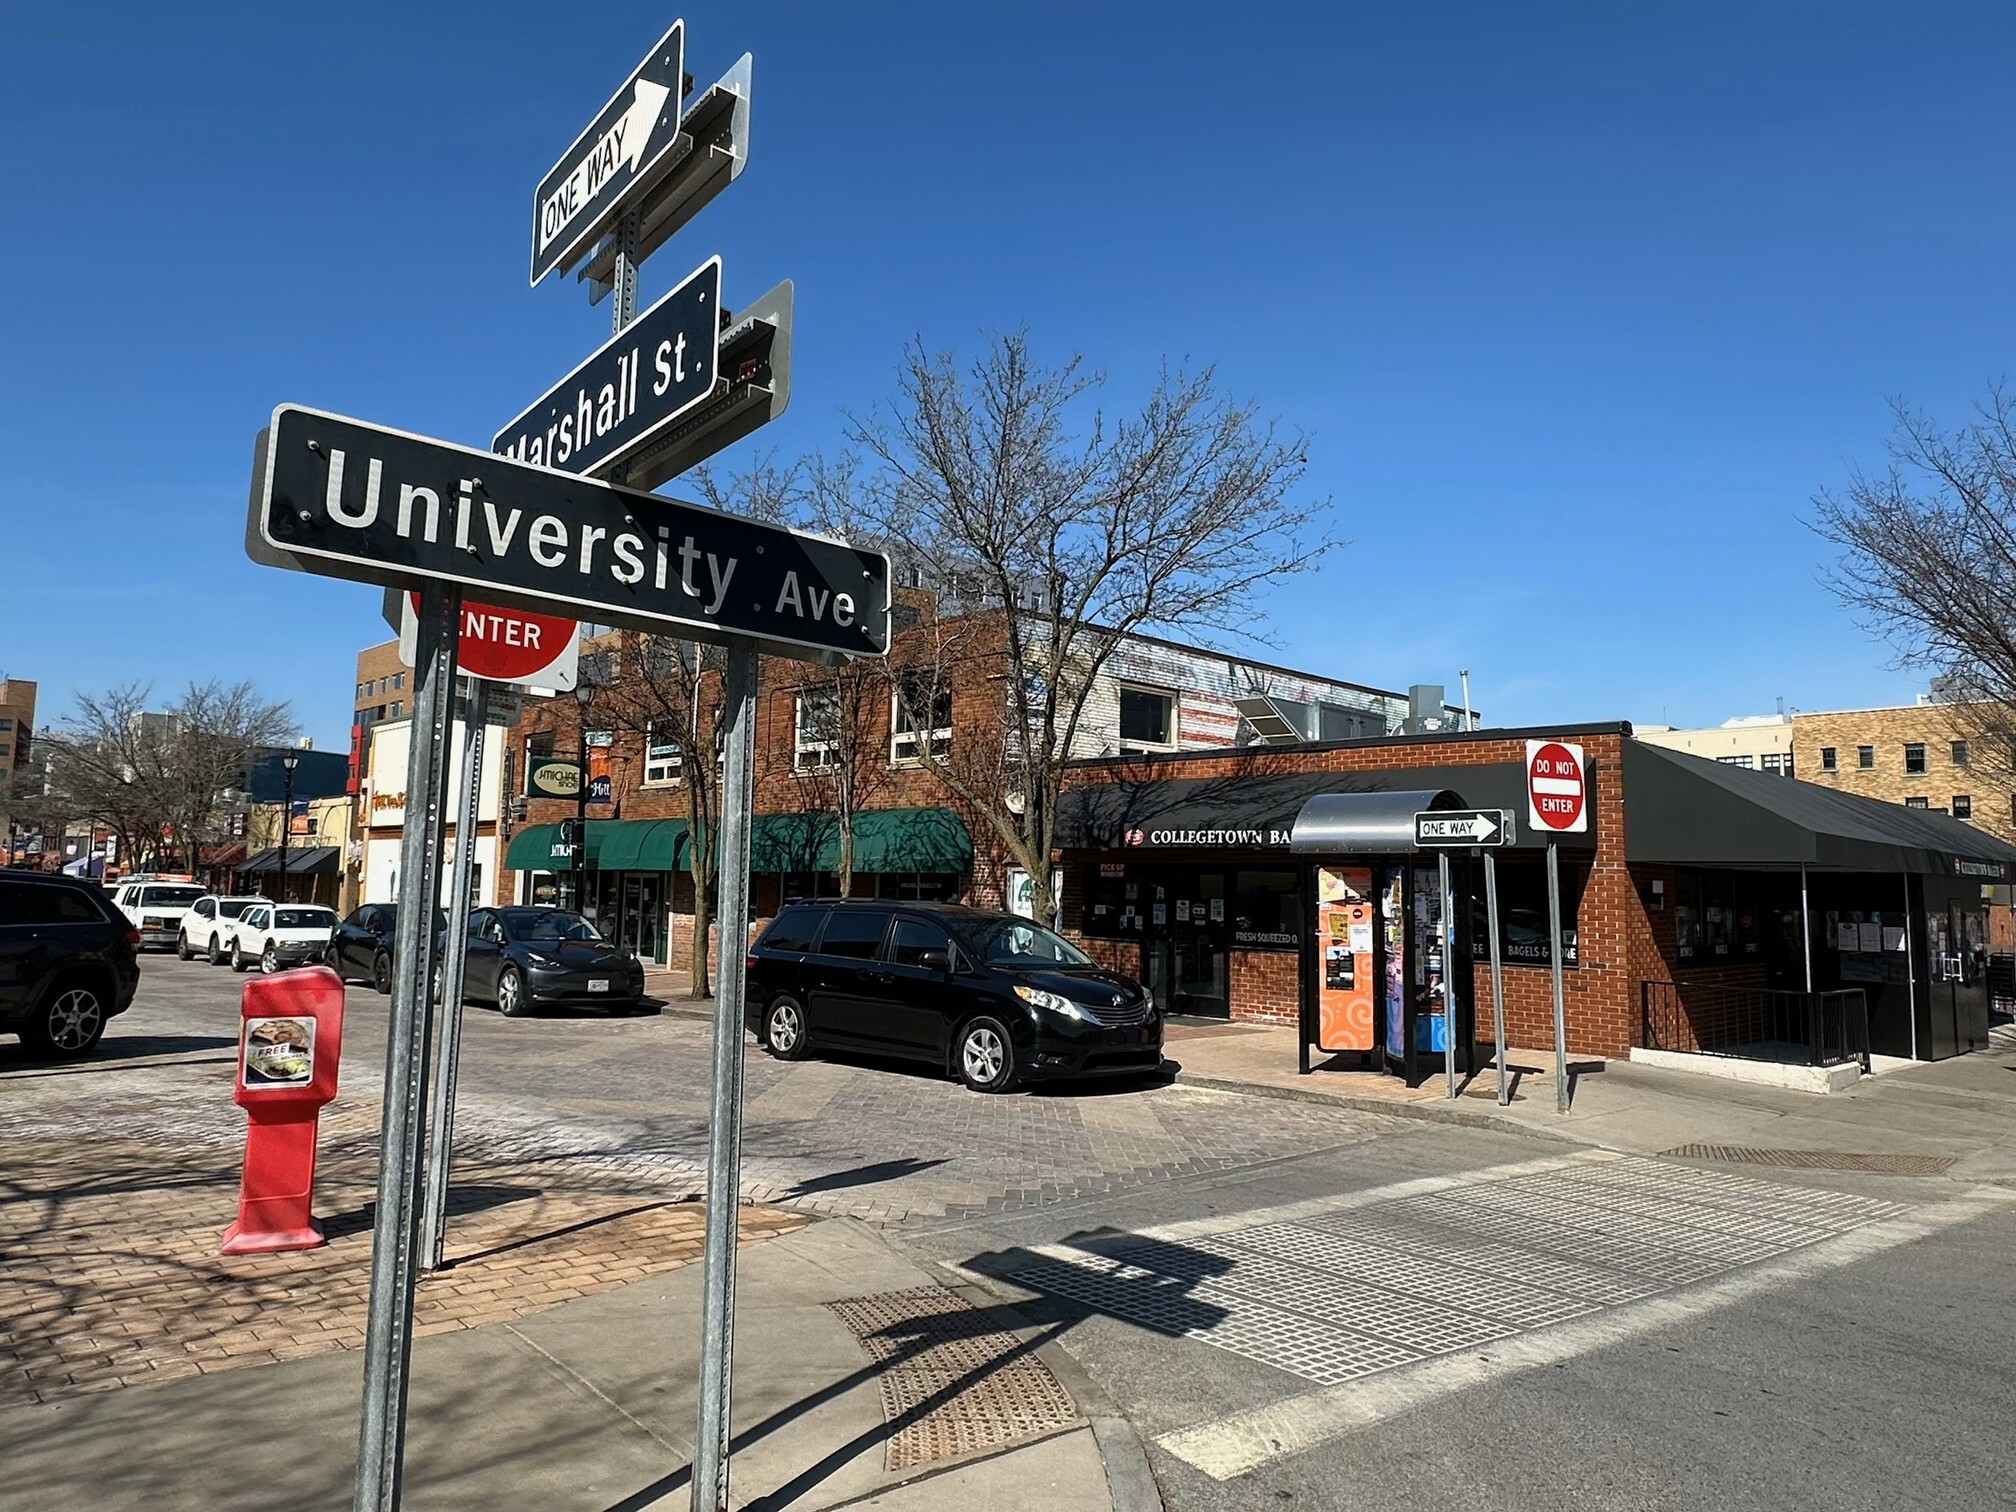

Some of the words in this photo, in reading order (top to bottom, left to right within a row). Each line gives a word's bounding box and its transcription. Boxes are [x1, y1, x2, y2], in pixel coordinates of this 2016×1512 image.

[545, 172, 580, 239] ONE
[587, 116, 629, 195] WAY
[653, 331, 687, 397] St
[326, 448, 738, 616] University
[775, 570, 856, 628] Ave
[460, 610, 541, 650] NTER
[1536, 759, 1550, 774] DO
[1556, 761, 1575, 775] NOT
[1542, 798, 1574, 814] ENTER
[1423, 823, 1446, 835] ONE
[1450, 822, 1474, 835] WAY
[1151, 829, 1263, 845] COLLEGETOWN
[1269, 829, 1292, 844] BA
[1100, 863, 1116, 871] PICK
[1116, 863, 1126, 871] UP
[1235, 931, 1256, 942] FRESH
[1257, 932, 1291, 944] SQUEEZED
[1508, 945, 1540, 958] BAGELS
[1541, 947, 1549, 958] &
[1559, 947, 1577, 960] ORE
[257, 1044, 288, 1057] FREE
